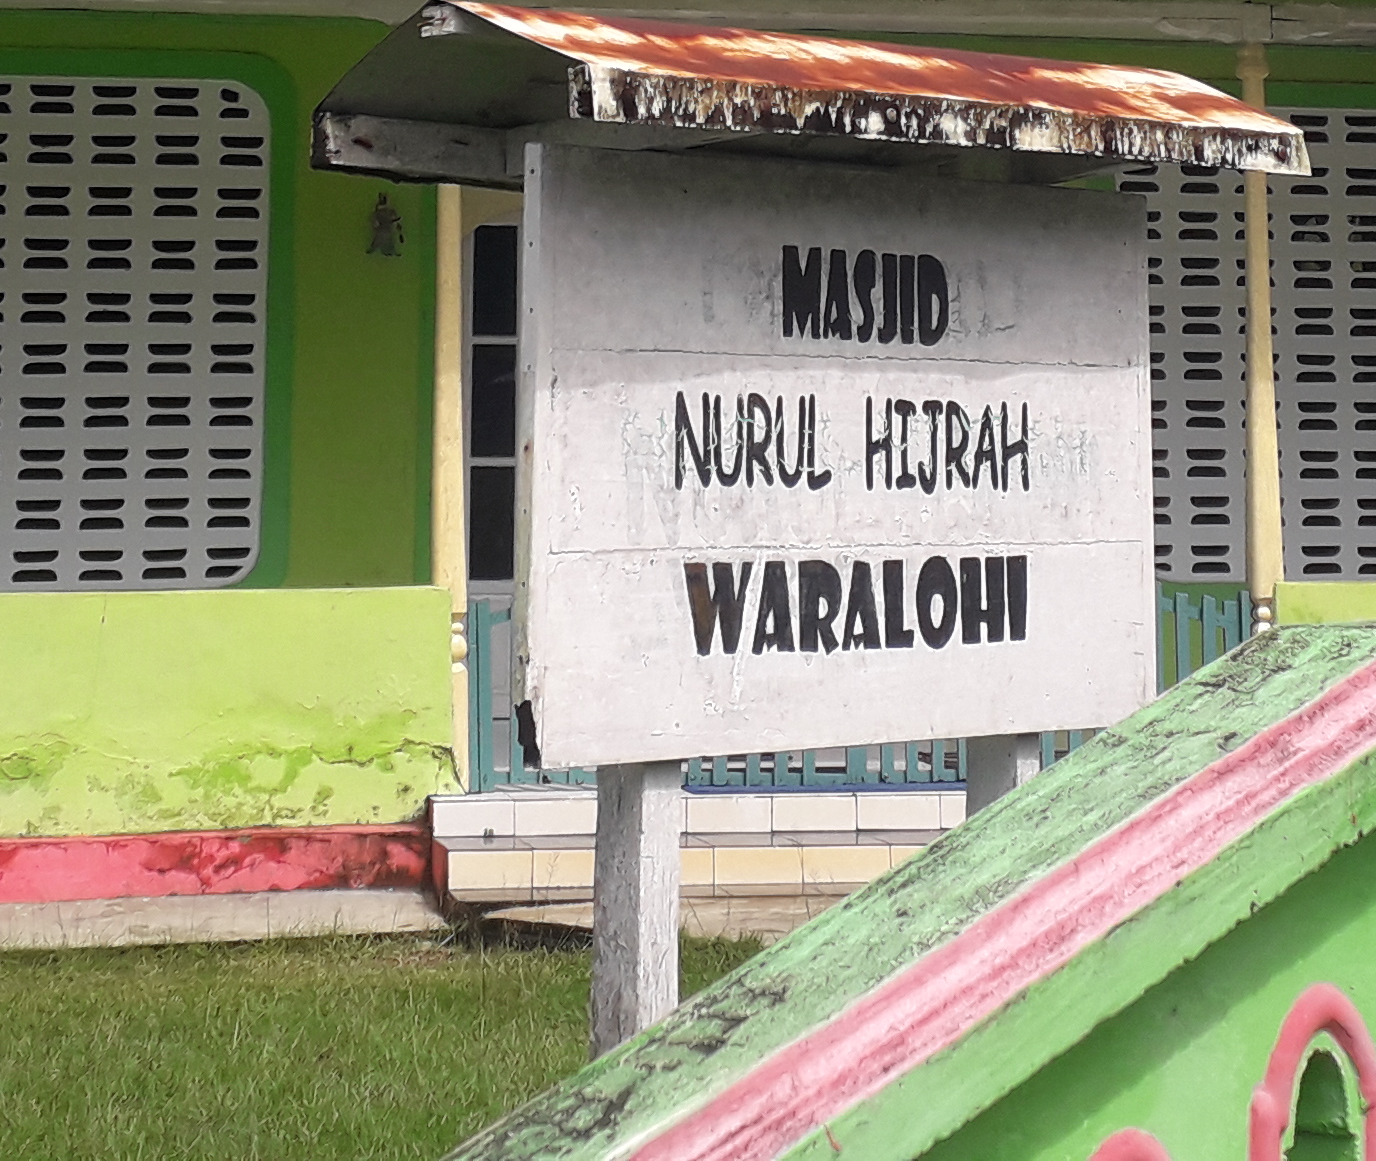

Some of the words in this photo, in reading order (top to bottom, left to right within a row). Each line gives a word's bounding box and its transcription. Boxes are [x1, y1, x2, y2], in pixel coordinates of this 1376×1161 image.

[781, 244, 949, 346] MASJID
[674, 390, 832, 491] NURUL
[864, 396, 1030, 494] HIJRAH
[683, 554, 1028, 656] WARALOHI
